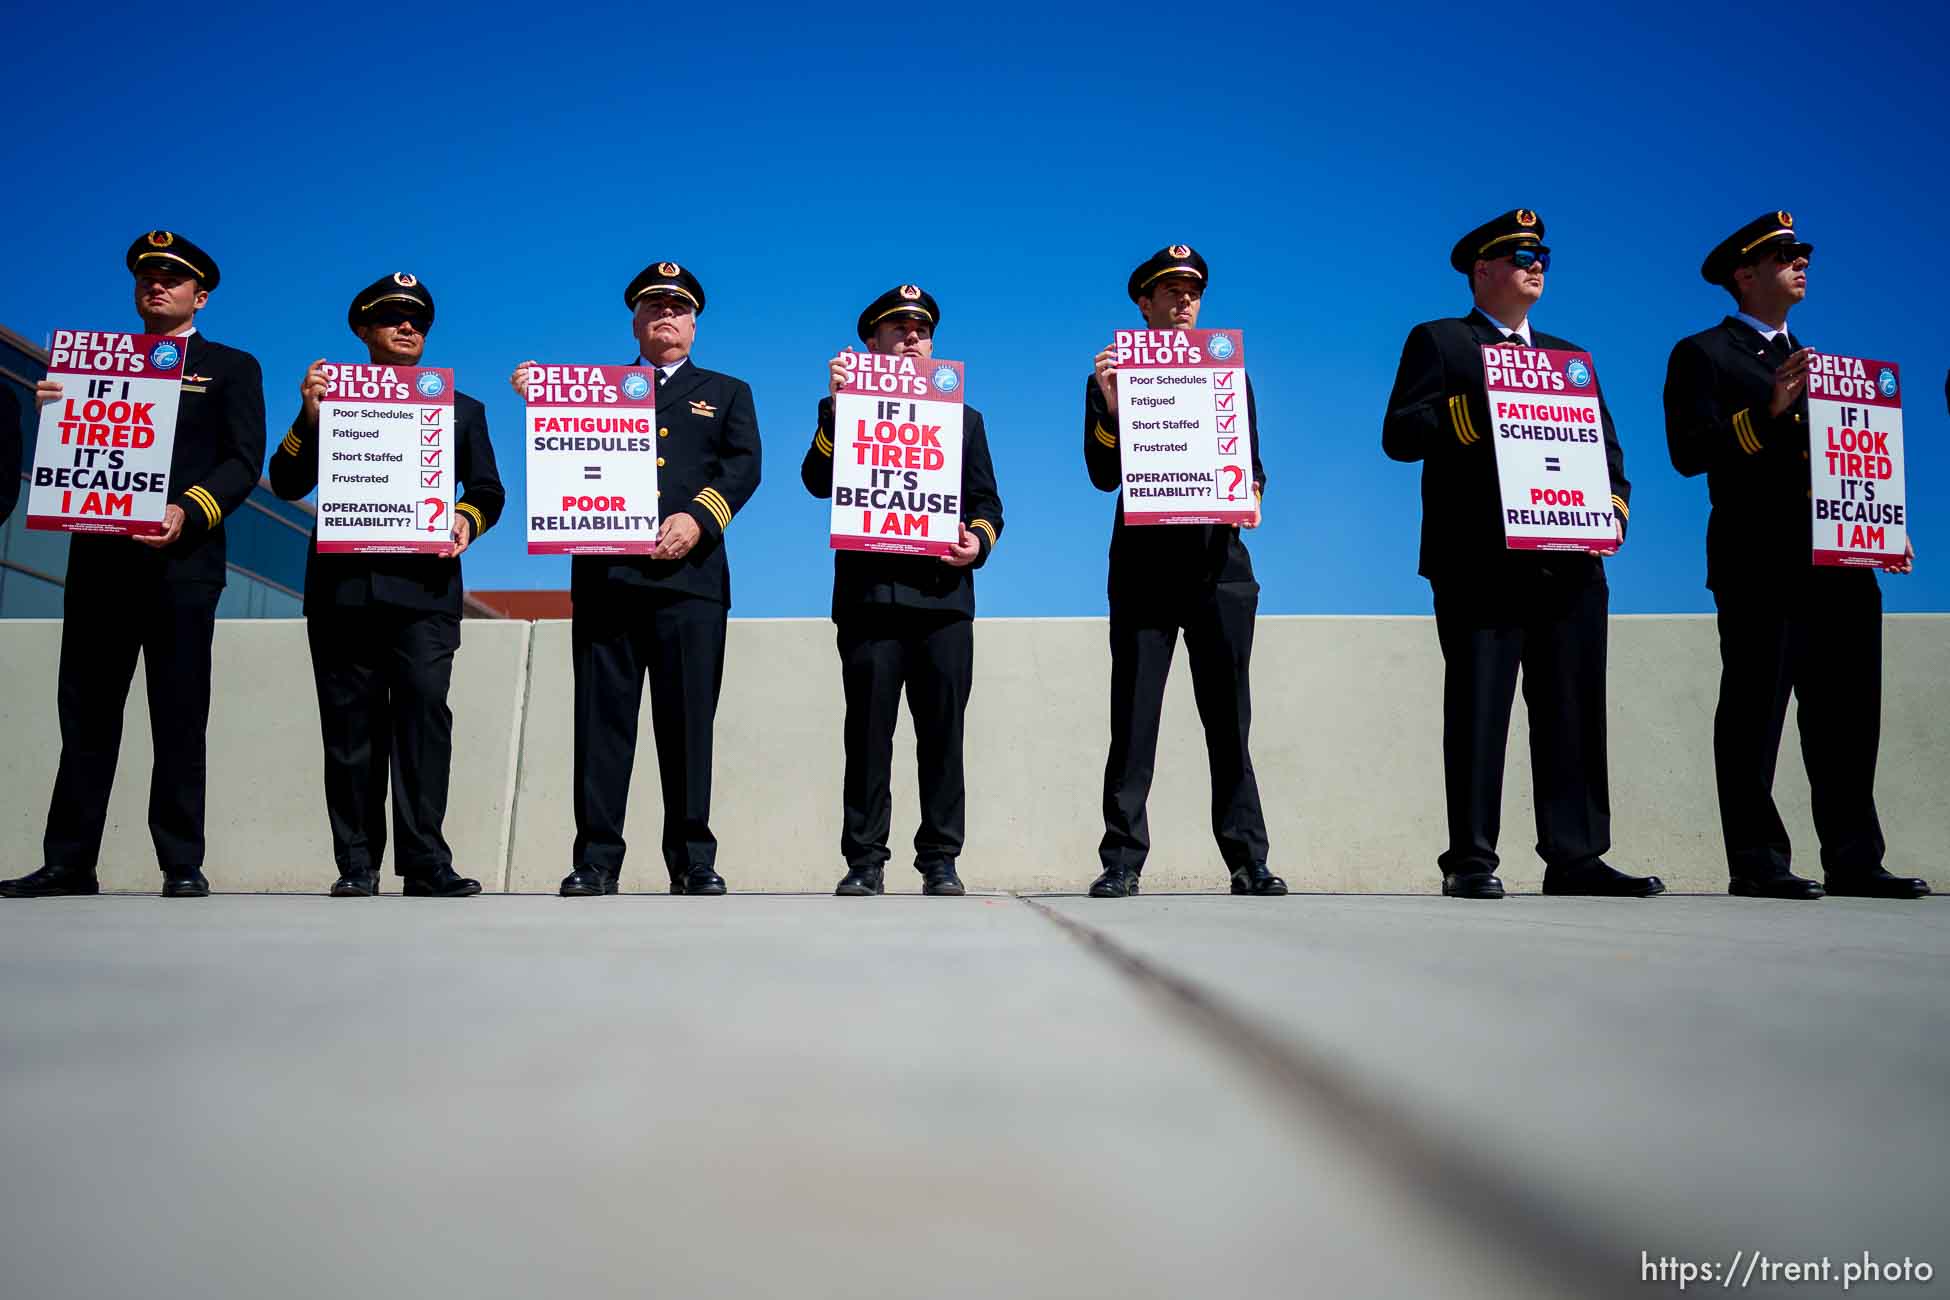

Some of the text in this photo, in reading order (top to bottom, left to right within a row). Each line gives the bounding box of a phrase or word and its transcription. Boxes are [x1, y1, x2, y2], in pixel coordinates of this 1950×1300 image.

[55, 331, 134, 352] DELTA
[1116, 331, 1189, 348] DELTA
[51, 350, 144, 372] PILOTS
[840, 352, 916, 375] DELTA
[1117, 348, 1201, 365] PILOTS
[1484, 348, 1552, 370] DELTA
[321, 365, 398, 383] DELTA
[1808, 353, 1866, 379] DELTA
[528, 367, 605, 384] DELTA
[1130, 375, 1207, 385] Poor Schedules
[1487, 367, 1565, 391] PILOTS
[88, 380, 130, 400] IF I
[325, 382, 409, 400] PILOTS
[528, 385, 618, 403] PILOTS
[1809, 374, 1875, 400] PILOTS
[1131, 396, 1175, 407] Fatigued
[64, 399, 155, 425] LOOK
[333, 409, 414, 419] Poor Schedules
[878, 401, 916, 422] IF I
[1497, 403, 1595, 423] FATIGUING
[1841, 407, 1869, 428] IF I
[332, 429, 379, 439] Fatigued
[534, 418, 649, 433] FATIGUING
[857, 420, 942, 447] LOOK
[1132, 420, 1199, 430] Short Staffed
[1500, 424, 1598, 443] SCHEDULES
[57, 421, 154, 449] TIRED
[534, 437, 650, 451] SCHEDULES
[1828, 427, 1889, 456] LOOK
[852, 442, 944, 470] TIRED
[1134, 443, 1187, 452] Frustrated
[332, 452, 402, 462] Short Staffed
[1825, 451, 1892, 480] TIRED
[35, 467, 165, 493] BECAUSE
[332, 474, 389, 483] Frustrated
[1126, 472, 1214, 482] OPERATIONAL
[835, 487, 957, 514] BECAUSE
[1130, 487, 1211, 497] RELIABILITY?
[1530, 488, 1584, 506] POOR
[61, 491, 133, 516] I AM
[322, 503, 414, 513] OPERATIONAL
[562, 496, 626, 511] POOR
[1816, 499, 1904, 525] BECAUSE
[325, 517, 411, 527] RELIABILITY?
[531, 516, 656, 530] RELIABILITY
[863, 511, 929, 537] I AM
[1507, 509, 1612, 527] RELIABILITY
[1837, 524, 1885, 550] I AM
